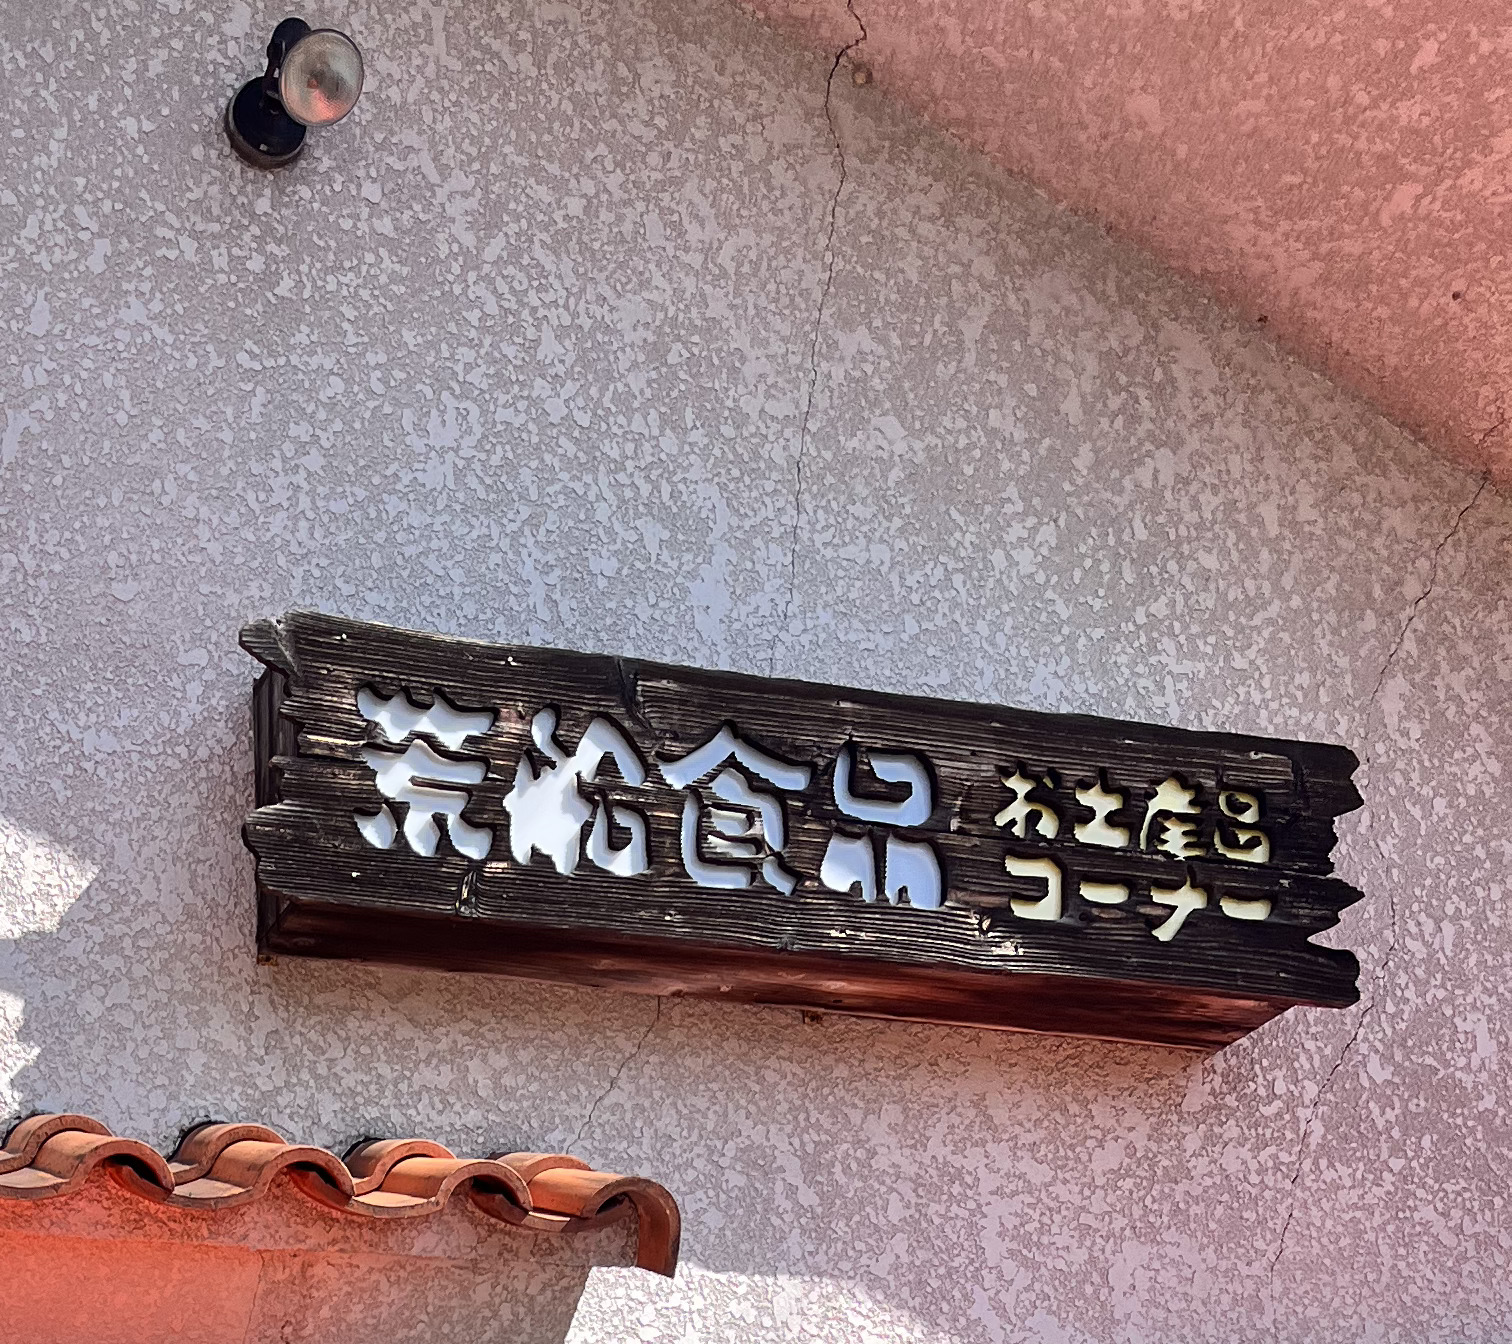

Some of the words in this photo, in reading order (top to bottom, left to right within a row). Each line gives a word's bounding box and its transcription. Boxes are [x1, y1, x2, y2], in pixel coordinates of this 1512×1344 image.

[994, 767, 1271, 864] お土産品
[1004, 855, 1273, 942] コーナー
